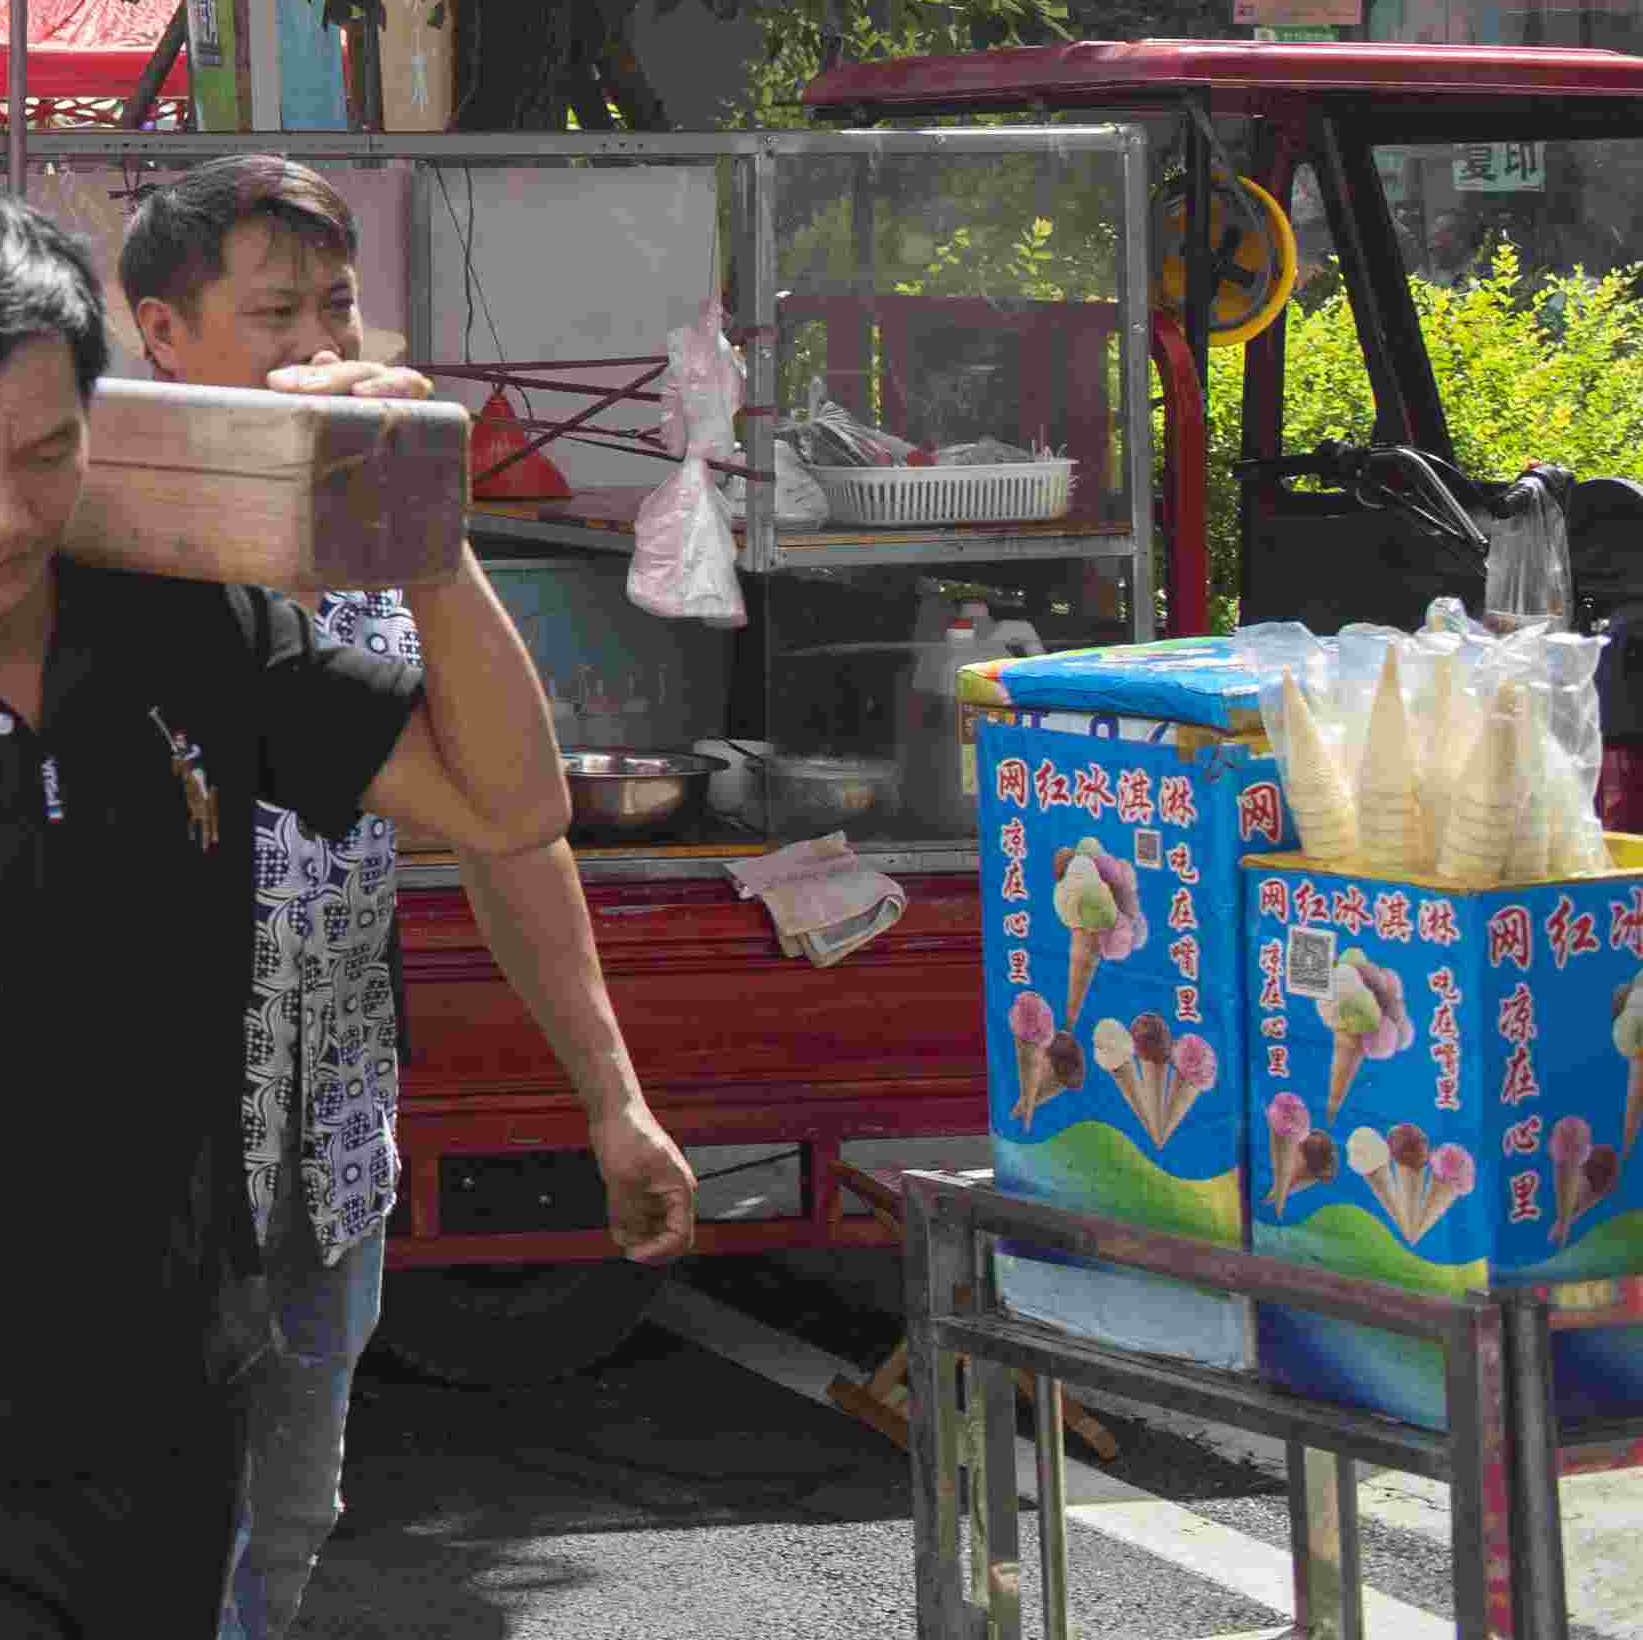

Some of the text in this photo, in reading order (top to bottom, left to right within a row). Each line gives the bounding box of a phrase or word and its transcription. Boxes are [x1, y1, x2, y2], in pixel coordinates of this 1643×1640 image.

[996, 758, 1199, 827] 网红冰淇淋
[1238, 781, 1283, 845] 网
[1259, 879, 1461, 945] 网红冰淇淋
[1498, 981, 1544, 1224] 凉在心里
